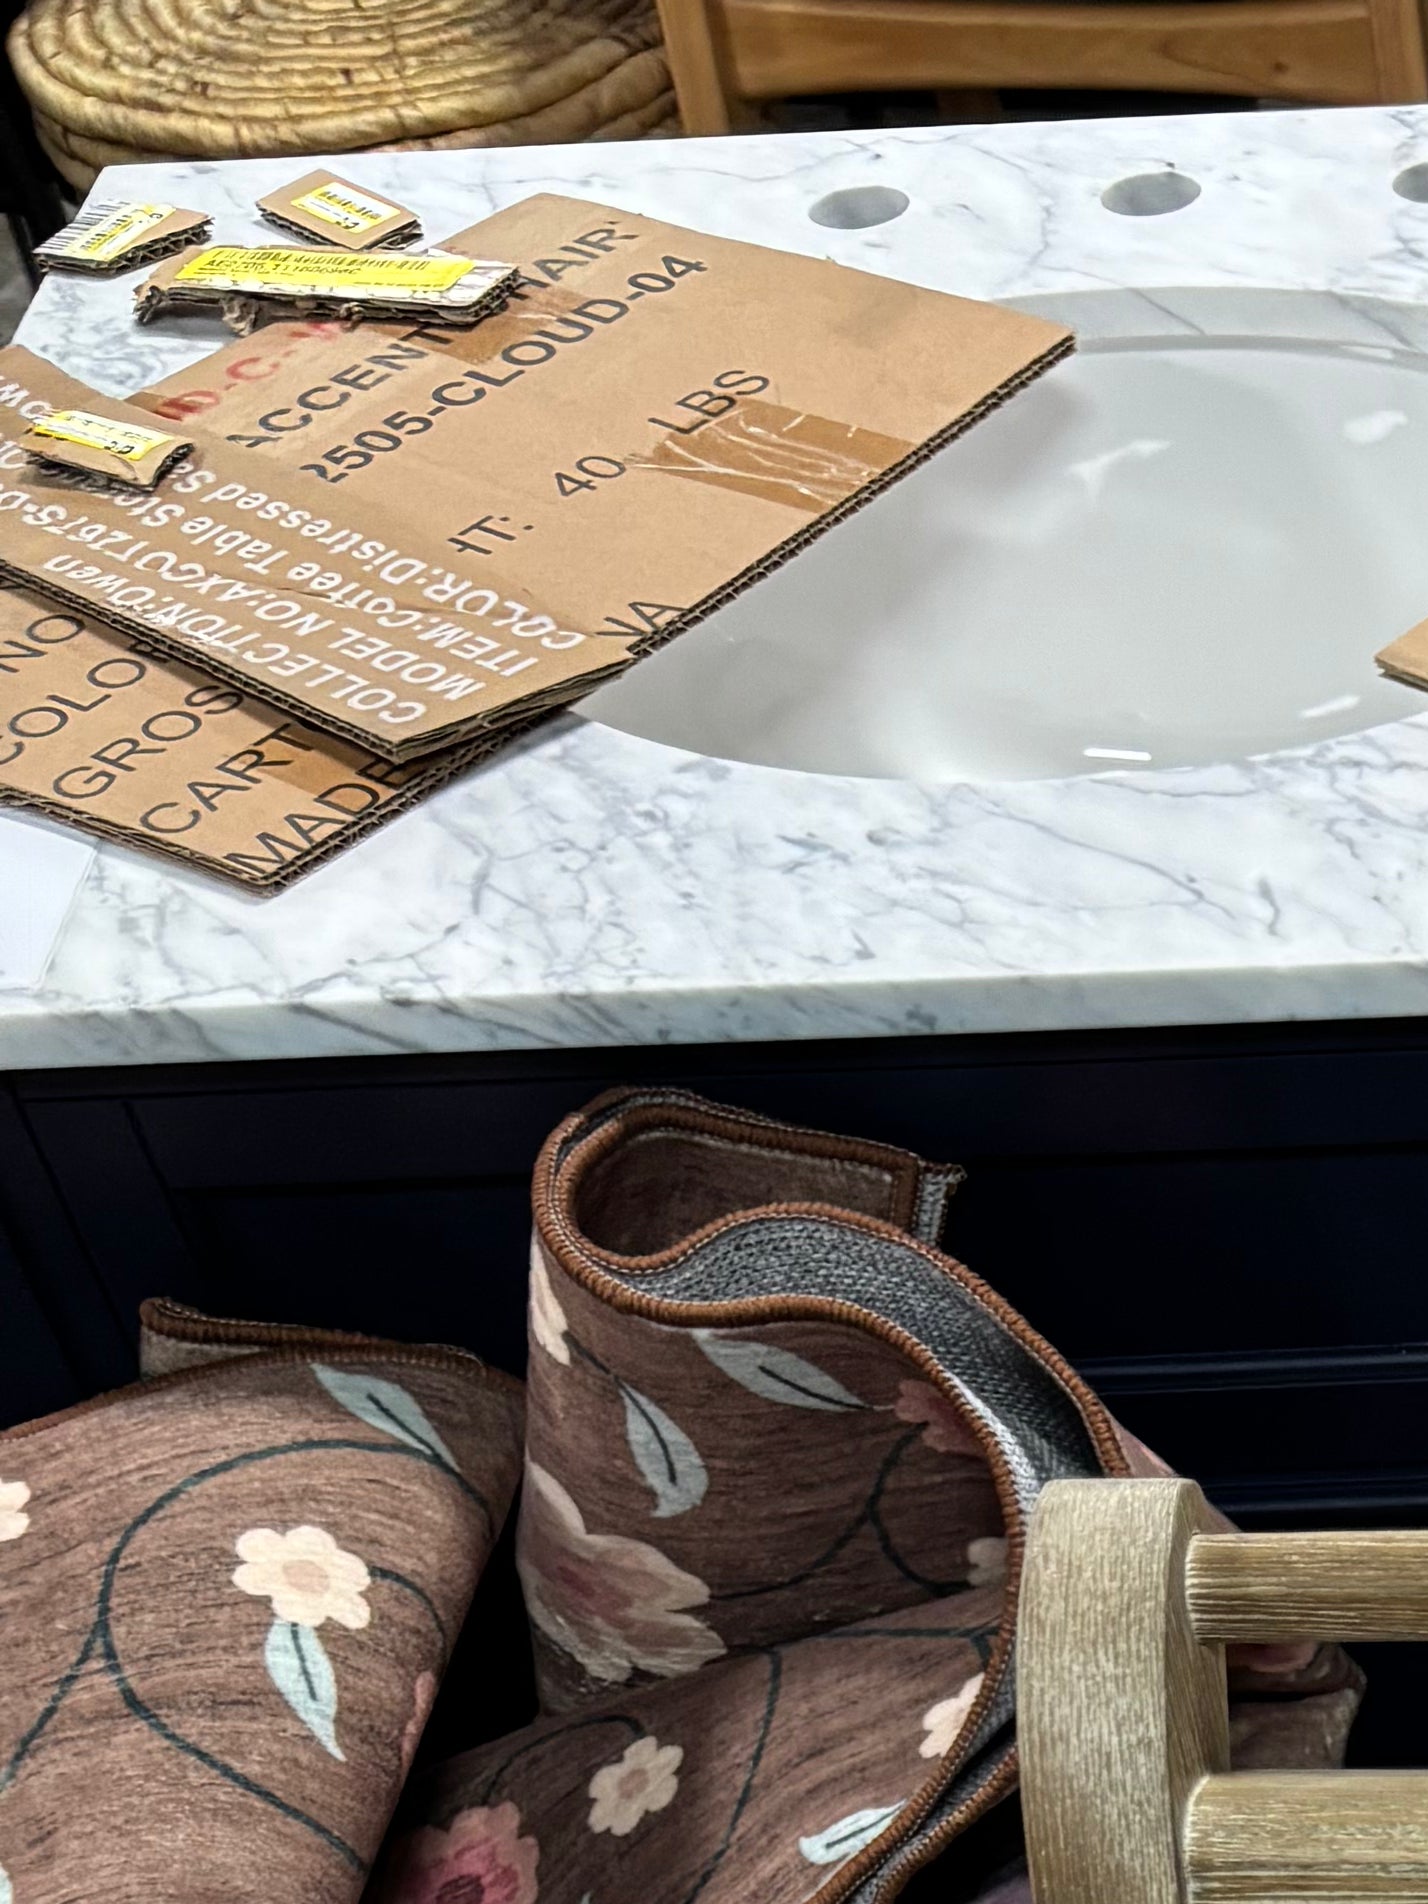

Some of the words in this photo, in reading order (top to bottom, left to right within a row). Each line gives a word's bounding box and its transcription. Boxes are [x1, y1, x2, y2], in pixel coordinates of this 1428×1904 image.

[554, 455, 627, 497] 40
[648, 369, 770, 435] LBS
[180, 514, 293, 575] Table
[329, 626, 487, 701] MODEL
[53, 684, 244, 799] GROS
